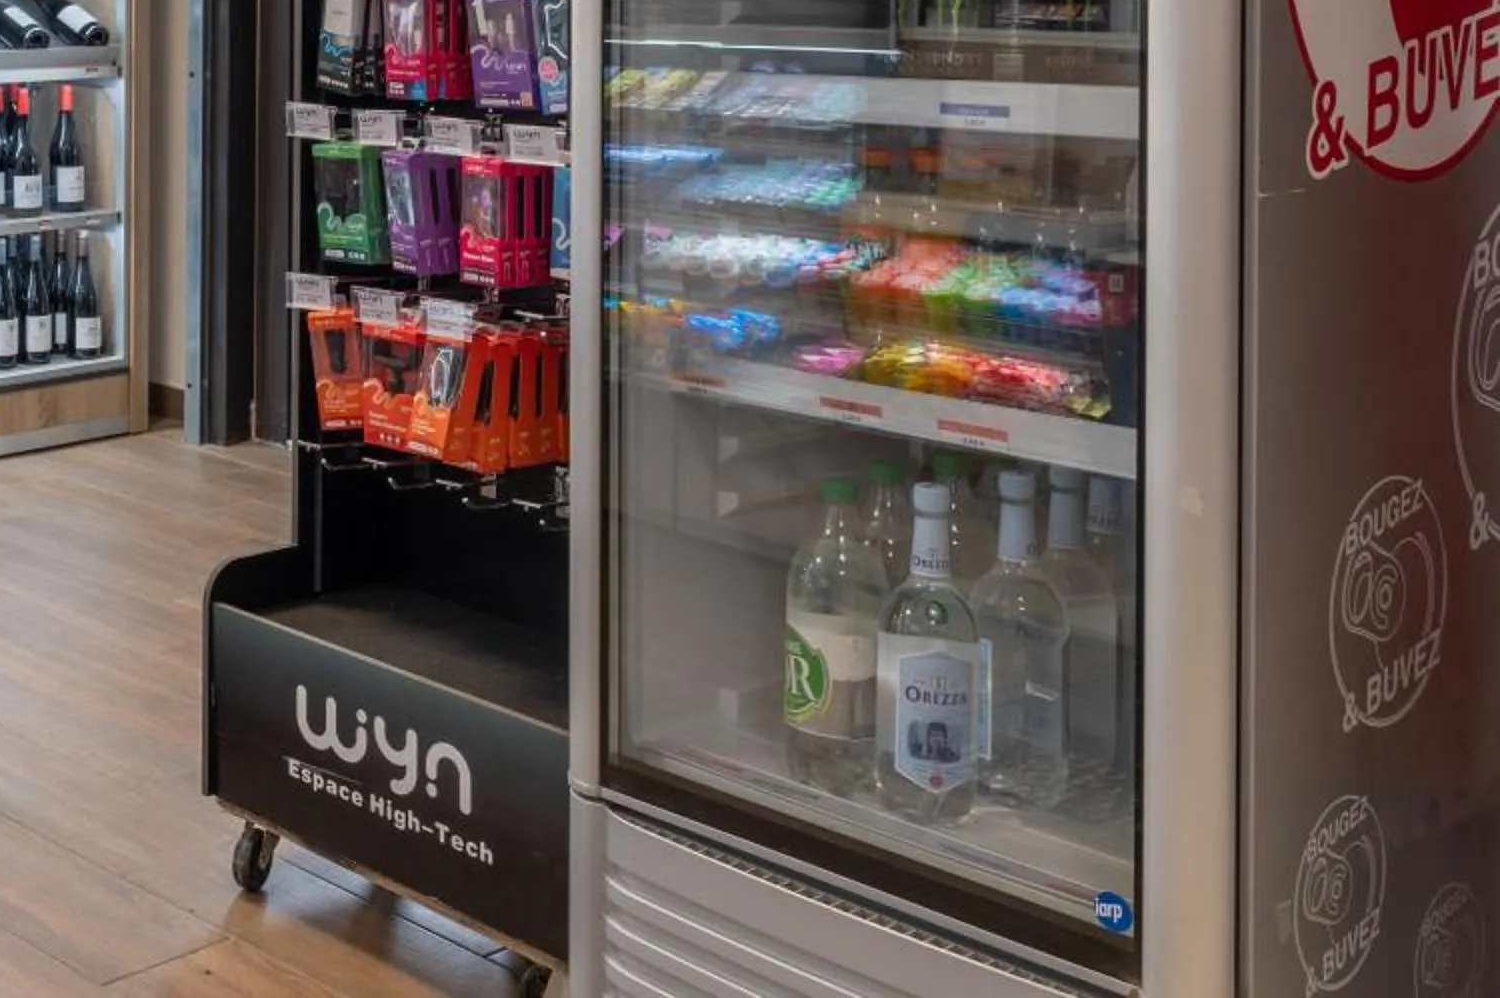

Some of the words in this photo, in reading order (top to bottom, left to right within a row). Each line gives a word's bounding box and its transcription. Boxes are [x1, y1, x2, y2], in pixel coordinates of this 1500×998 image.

[1308, 80, 1346, 174] &
[1366, 17, 1500, 149] BUVE
[1346, 478, 1423, 555] BOUGEZ
[1367, 627, 1441, 716] BUVEZ
[287, 757, 363, 808] Espace
[370, 793, 494, 866] High-Tech
[1306, 796, 1368, 862] BOUGEZ
[1323, 906, 1380, 981] BUVEZ
